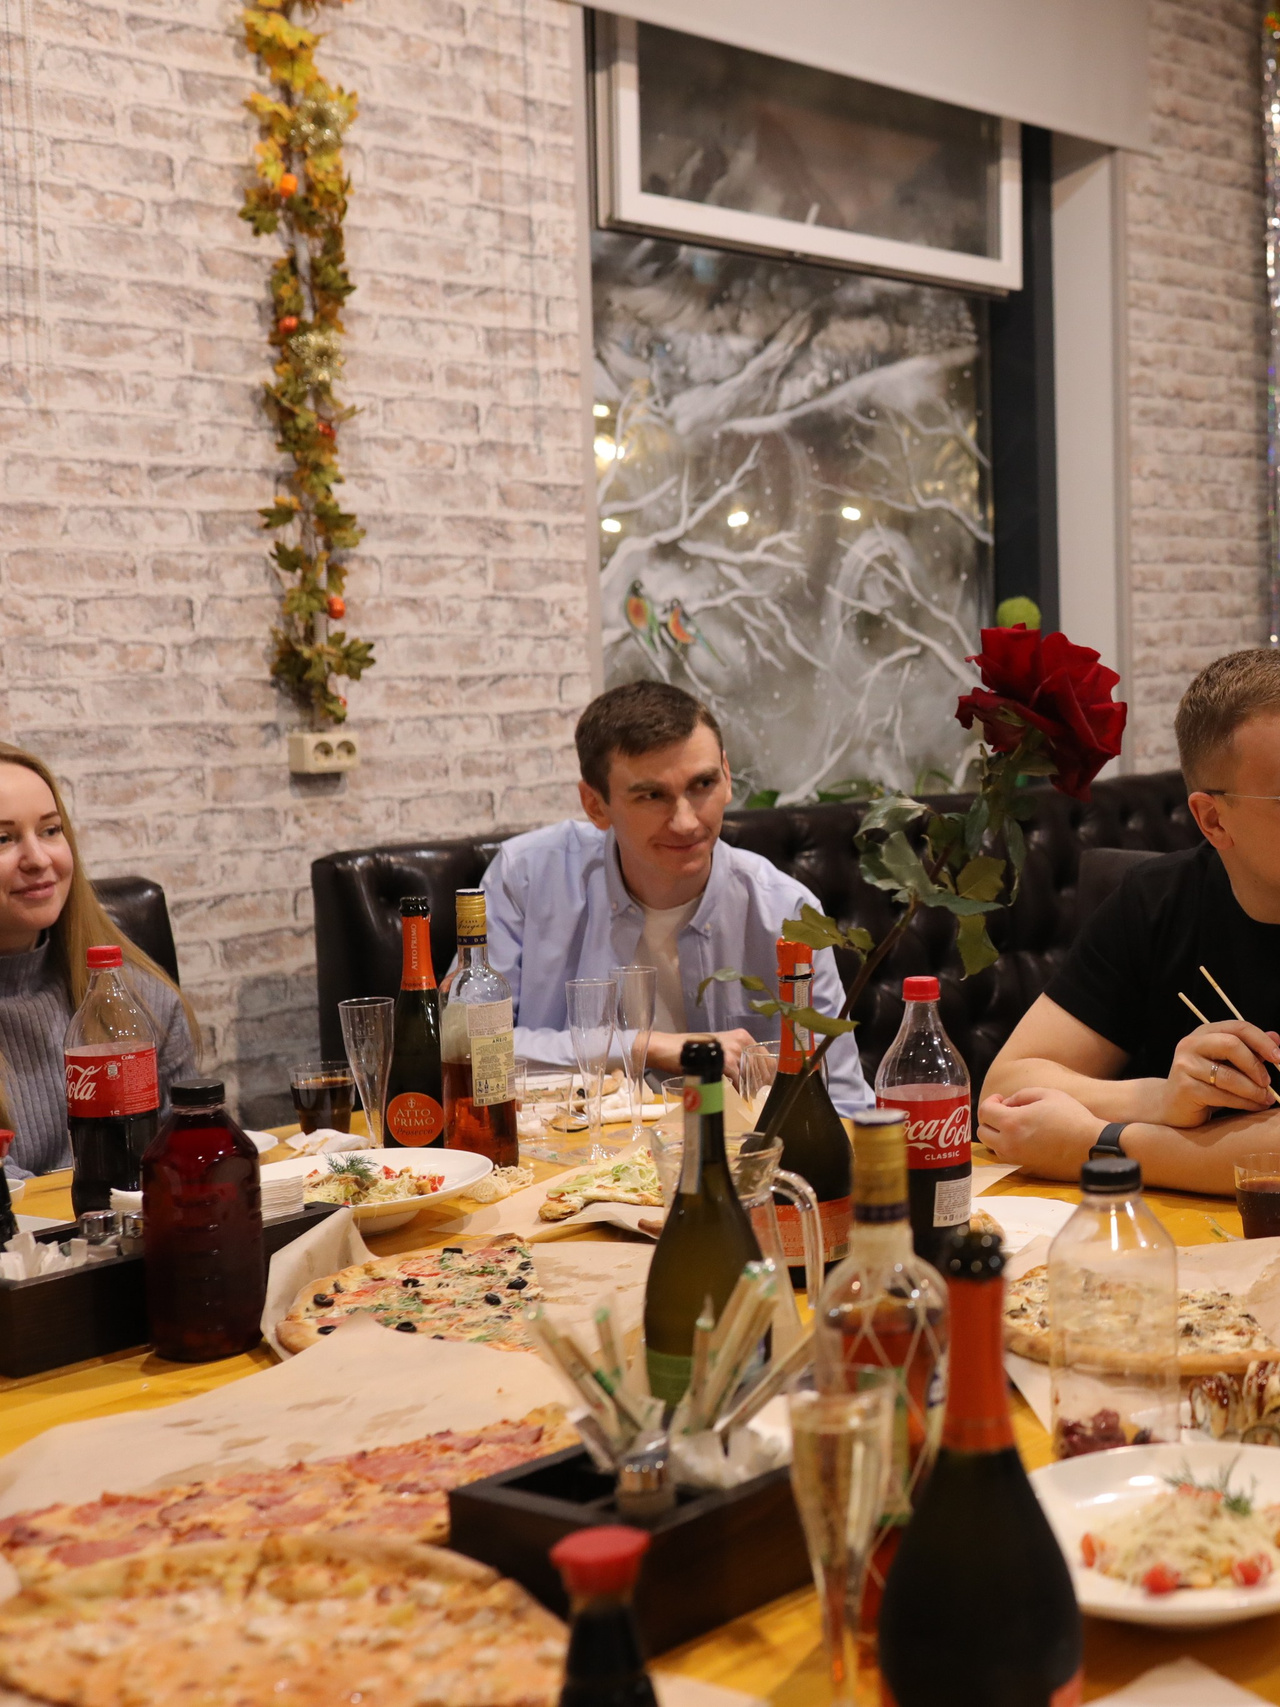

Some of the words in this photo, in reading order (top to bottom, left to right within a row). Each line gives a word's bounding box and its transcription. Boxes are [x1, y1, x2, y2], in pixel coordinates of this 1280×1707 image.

[396, 1108, 431, 1118] ATTO
[393, 1116, 435, 1127] PRIMO
[924, 1150, 960, 1161] CLASSIC
